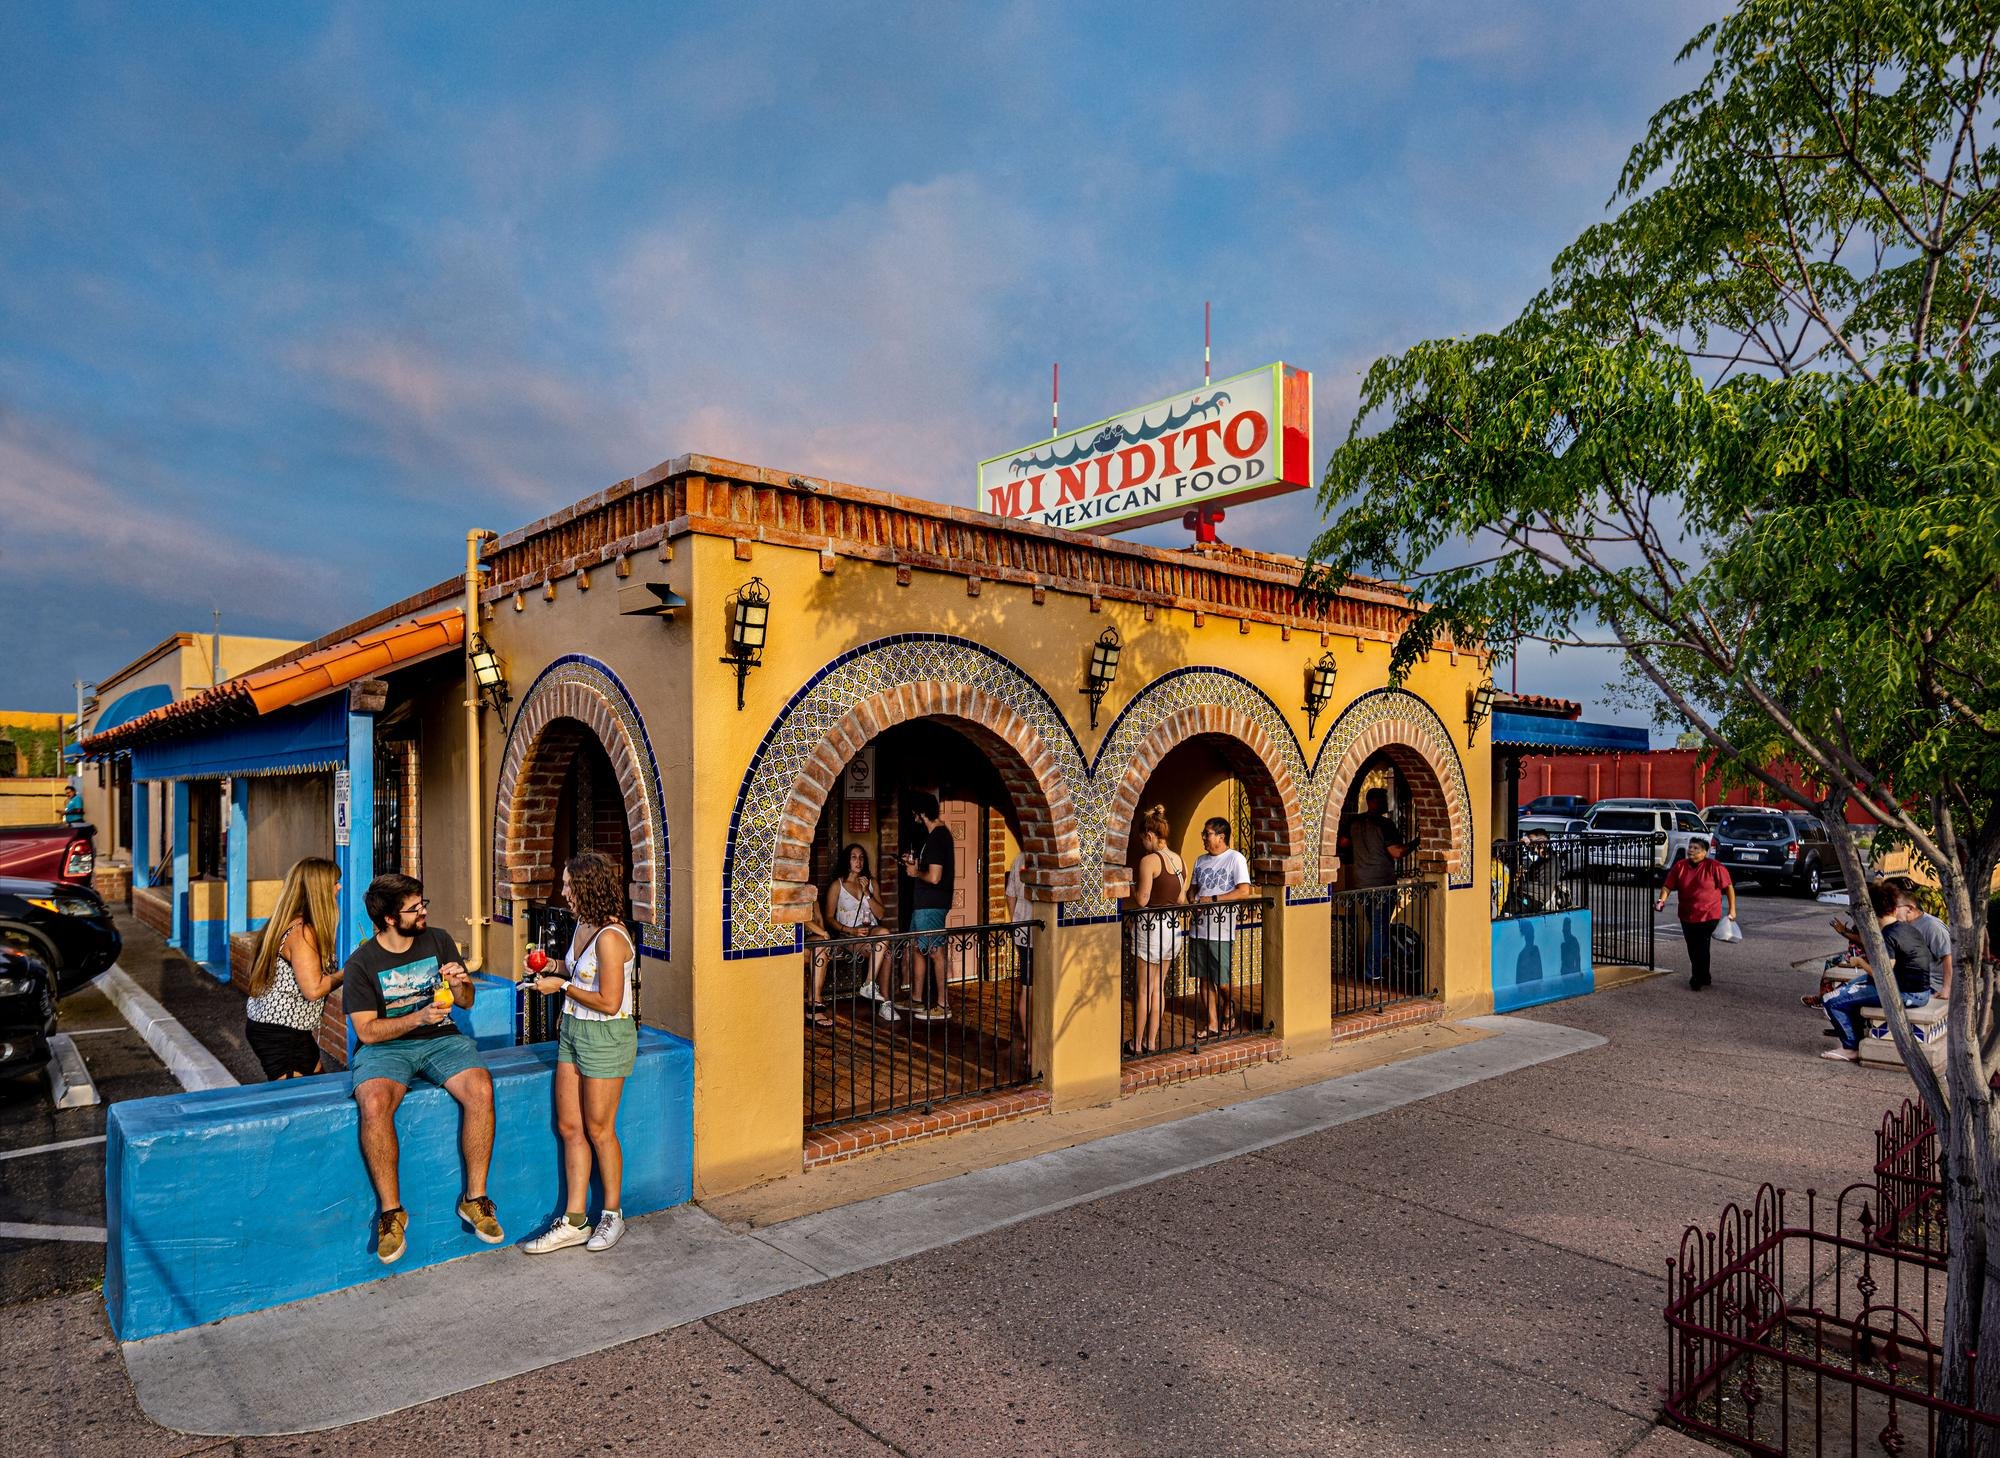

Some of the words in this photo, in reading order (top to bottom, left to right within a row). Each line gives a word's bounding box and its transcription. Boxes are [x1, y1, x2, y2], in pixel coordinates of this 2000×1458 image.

[987, 473, 1047, 518] MI
[1055, 410, 1269, 507] NIDITO
[1043, 483, 1161, 527] MEXICAN
[1175, 458, 1265, 498] FOOD
